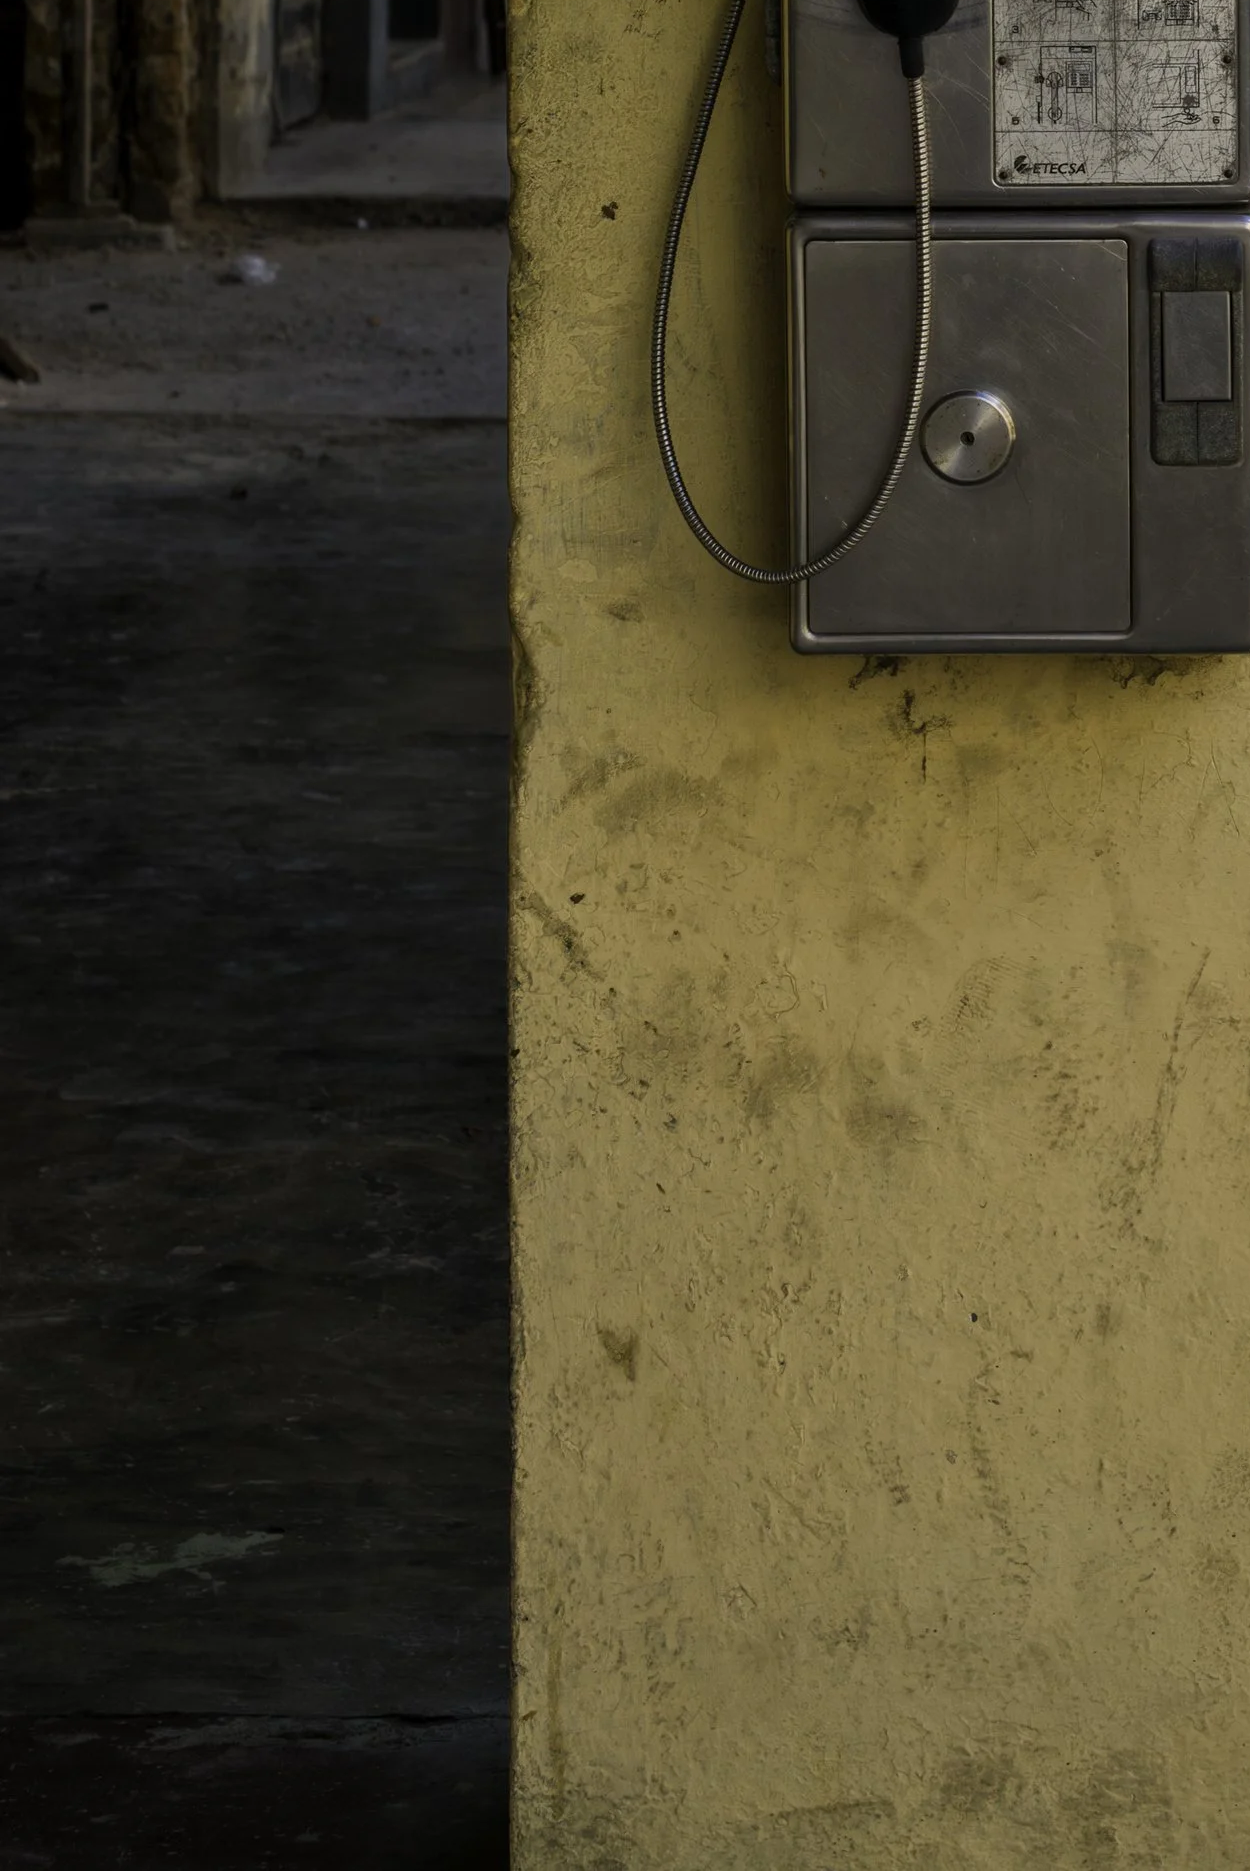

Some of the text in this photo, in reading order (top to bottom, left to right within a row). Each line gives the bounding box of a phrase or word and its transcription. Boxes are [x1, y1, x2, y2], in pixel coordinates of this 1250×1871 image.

[1011, 25, 1019, 34] 3
[1012, 116, 1020, 125] 5
[1212, 115, 1220, 125] 6
[1032, 162, 1086, 174] ETECSA
